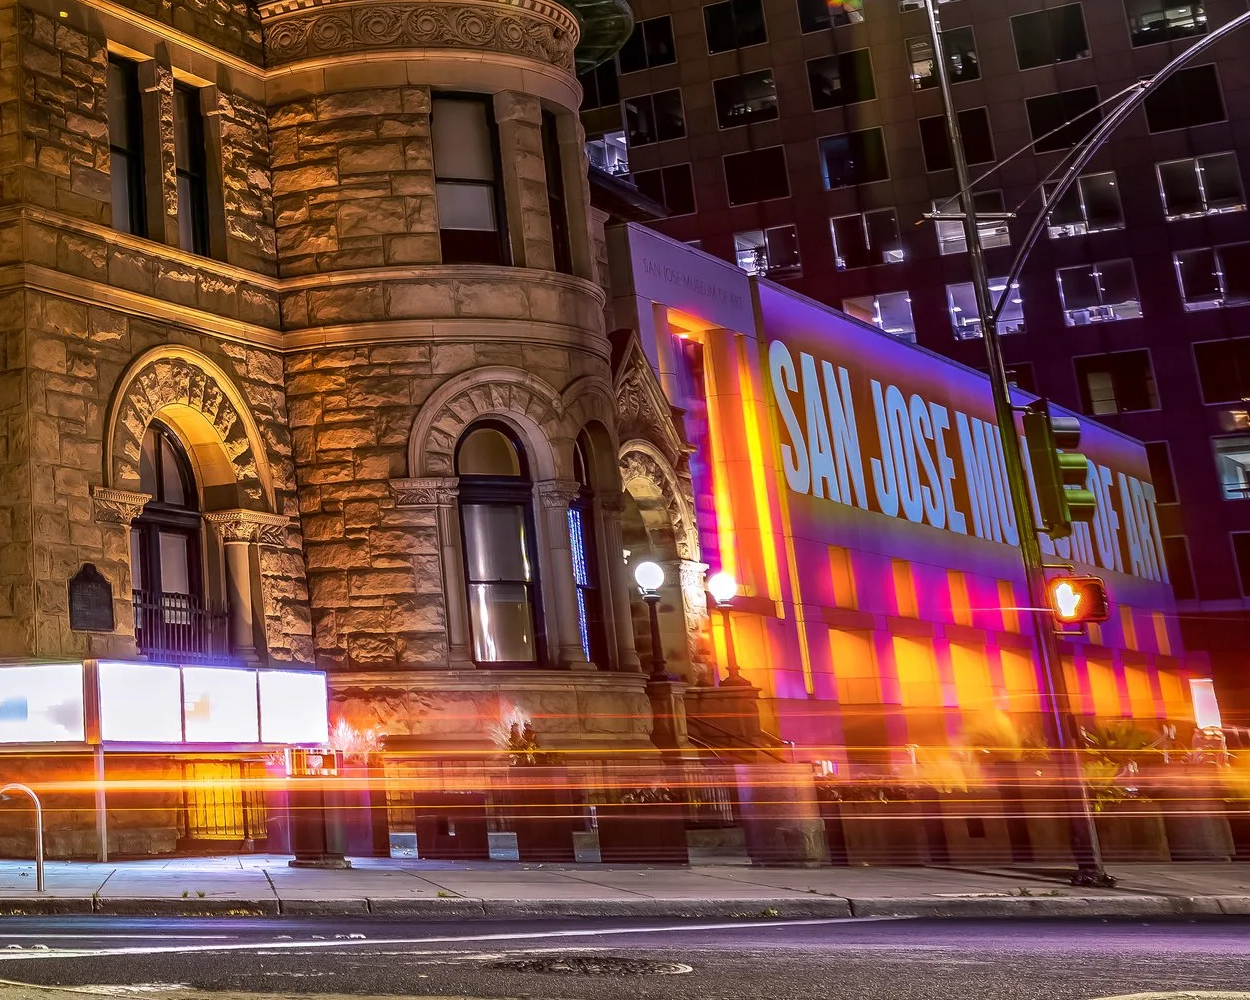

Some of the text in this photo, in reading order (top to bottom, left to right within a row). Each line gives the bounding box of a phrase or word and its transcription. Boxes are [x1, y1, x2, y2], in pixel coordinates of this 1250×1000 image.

[643, 258, 662, 279] SAN
[663, 265, 682, 287] JOSE
[683, 274, 718, 300] MUSEUM
[768, 339, 869, 511] SAN
[870, 379, 967, 535] JOSE
[1117, 472, 1170, 585] ART
